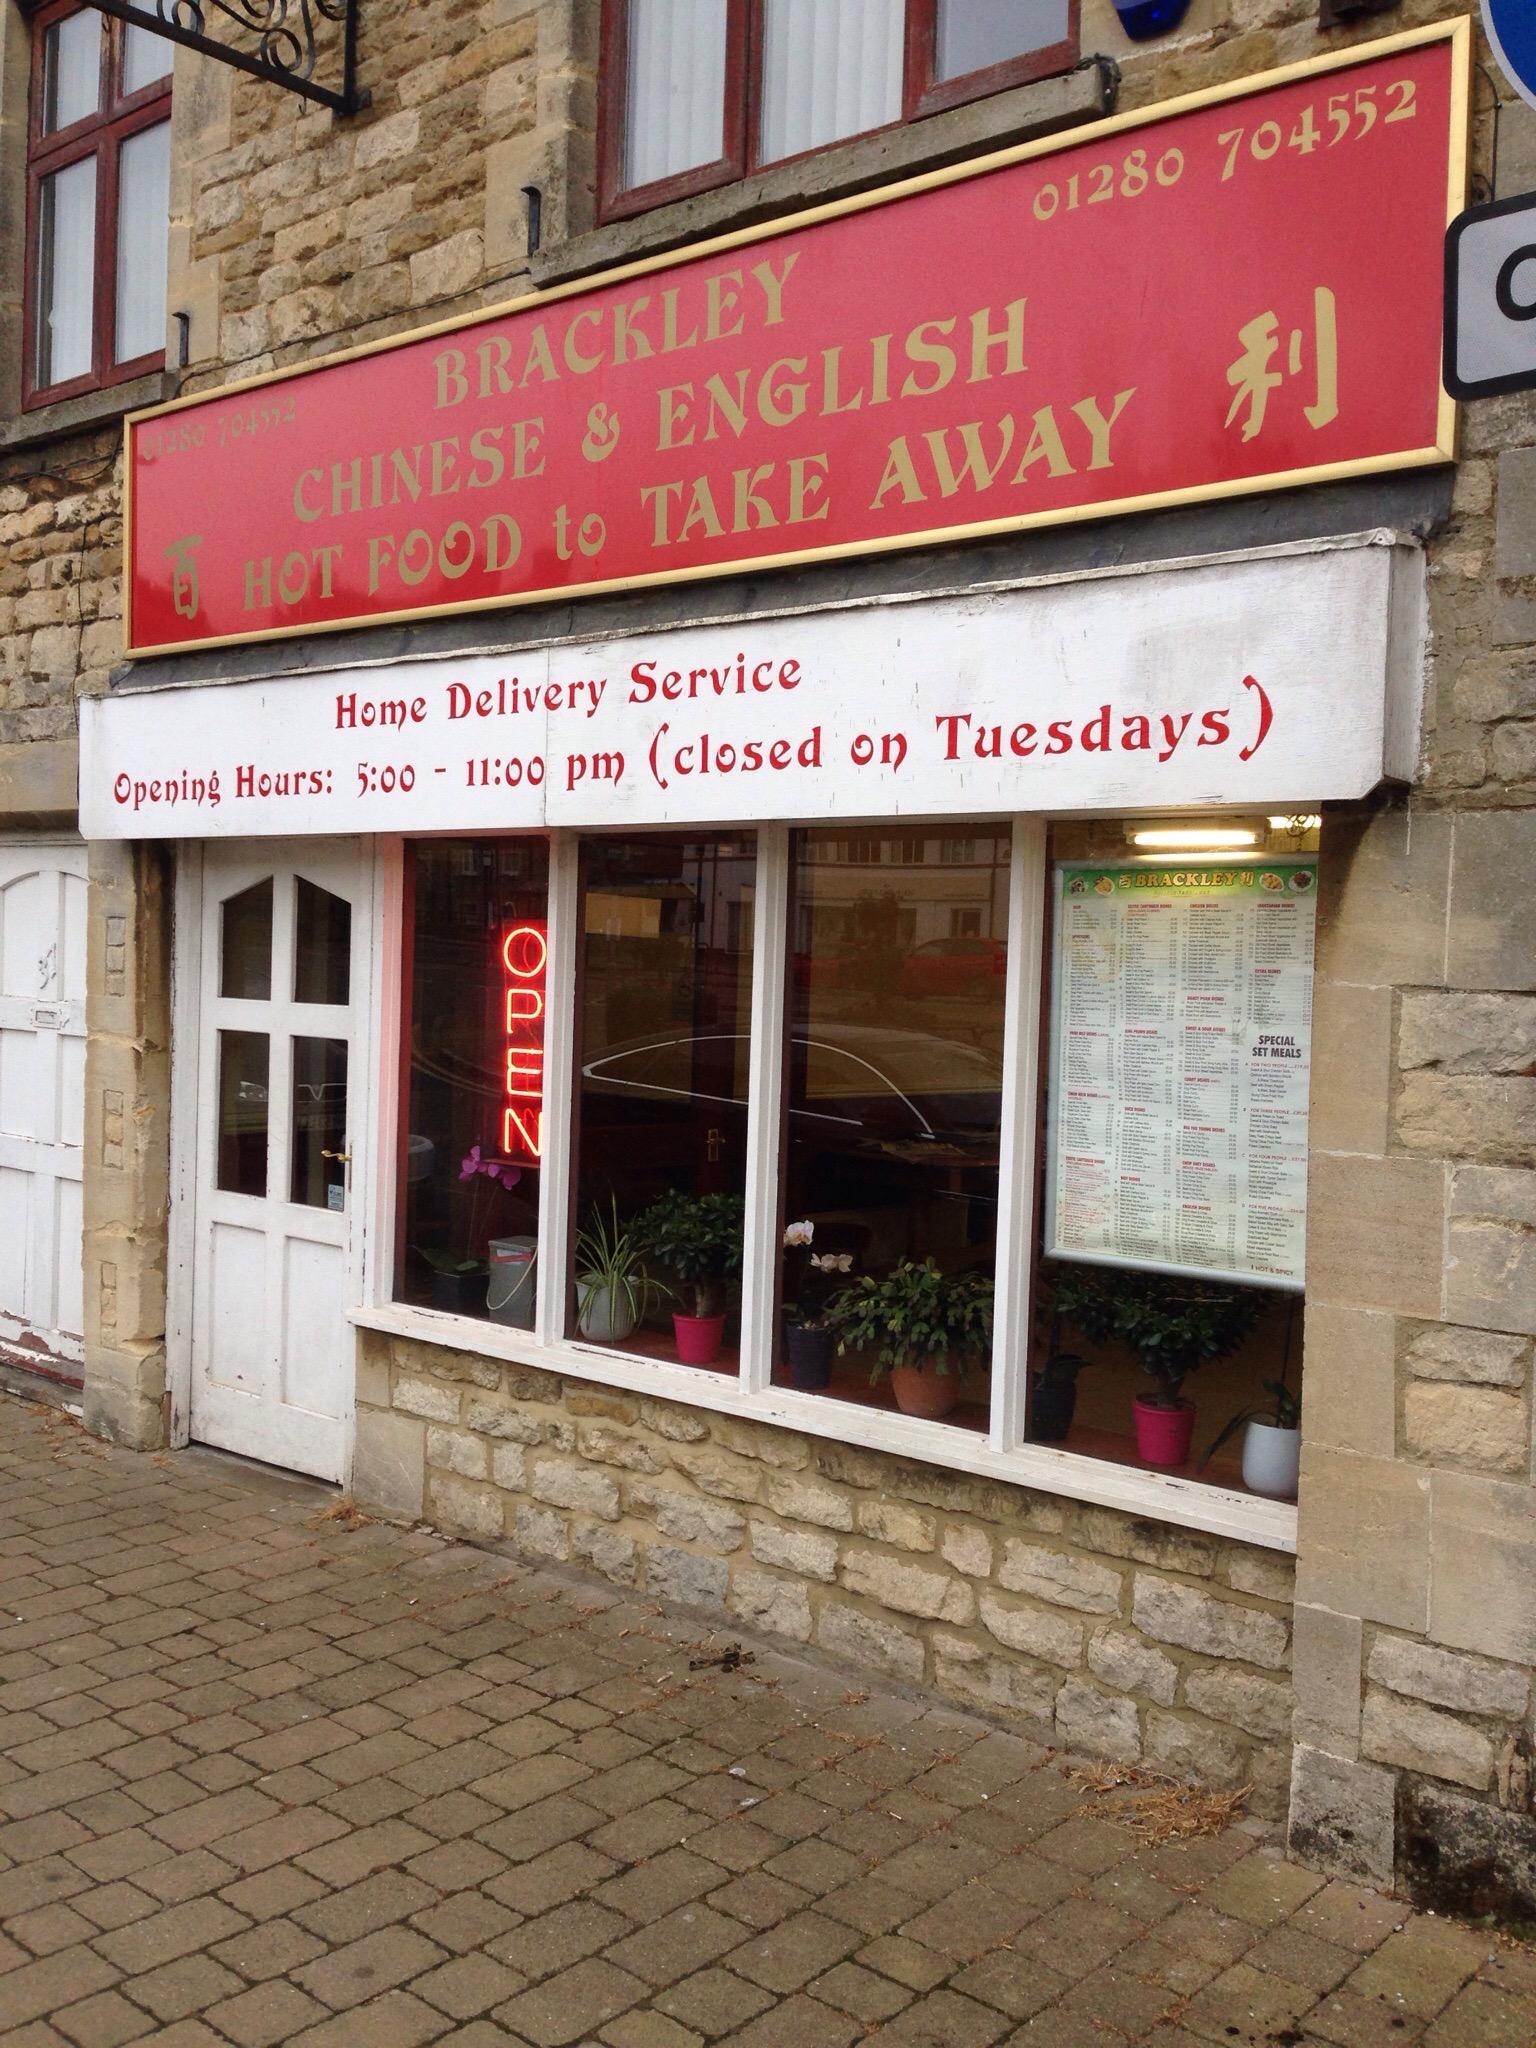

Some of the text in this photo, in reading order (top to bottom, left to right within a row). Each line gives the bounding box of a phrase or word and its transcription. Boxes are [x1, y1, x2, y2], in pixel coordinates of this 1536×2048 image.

[1032, 79, 1417, 221] 01280 704552
[434, 251, 802, 410] BRACKLEY
[1224, 286, 1338, 443] 利
[292, 297, 1028, 523] CHINESE & ENGLISH
[242, 387, 1138, 612] HOT FOOD to TAKE AWAY
[113, 770, 222, 809] Opening
[235, 764, 333, 798] Hours:
[356, 761, 416, 799] 5:00
[465, 755, 546, 788] 11:00
[566, 750, 625, 791] pm
[648, 722, 823, 790] (closed
[850, 731, 908, 775] on
[935, 674, 1275, 764] Tuesdays)
[335, 653, 803, 732] Home Delivery Service
[1135, 871, 1238, 889] BRACKLEY
[503, 927, 548, 1157] OPEN
[1252, 1046, 1302, 1059] SET MEALS
[1258, 1034, 1296, 1047] SPECIAL
